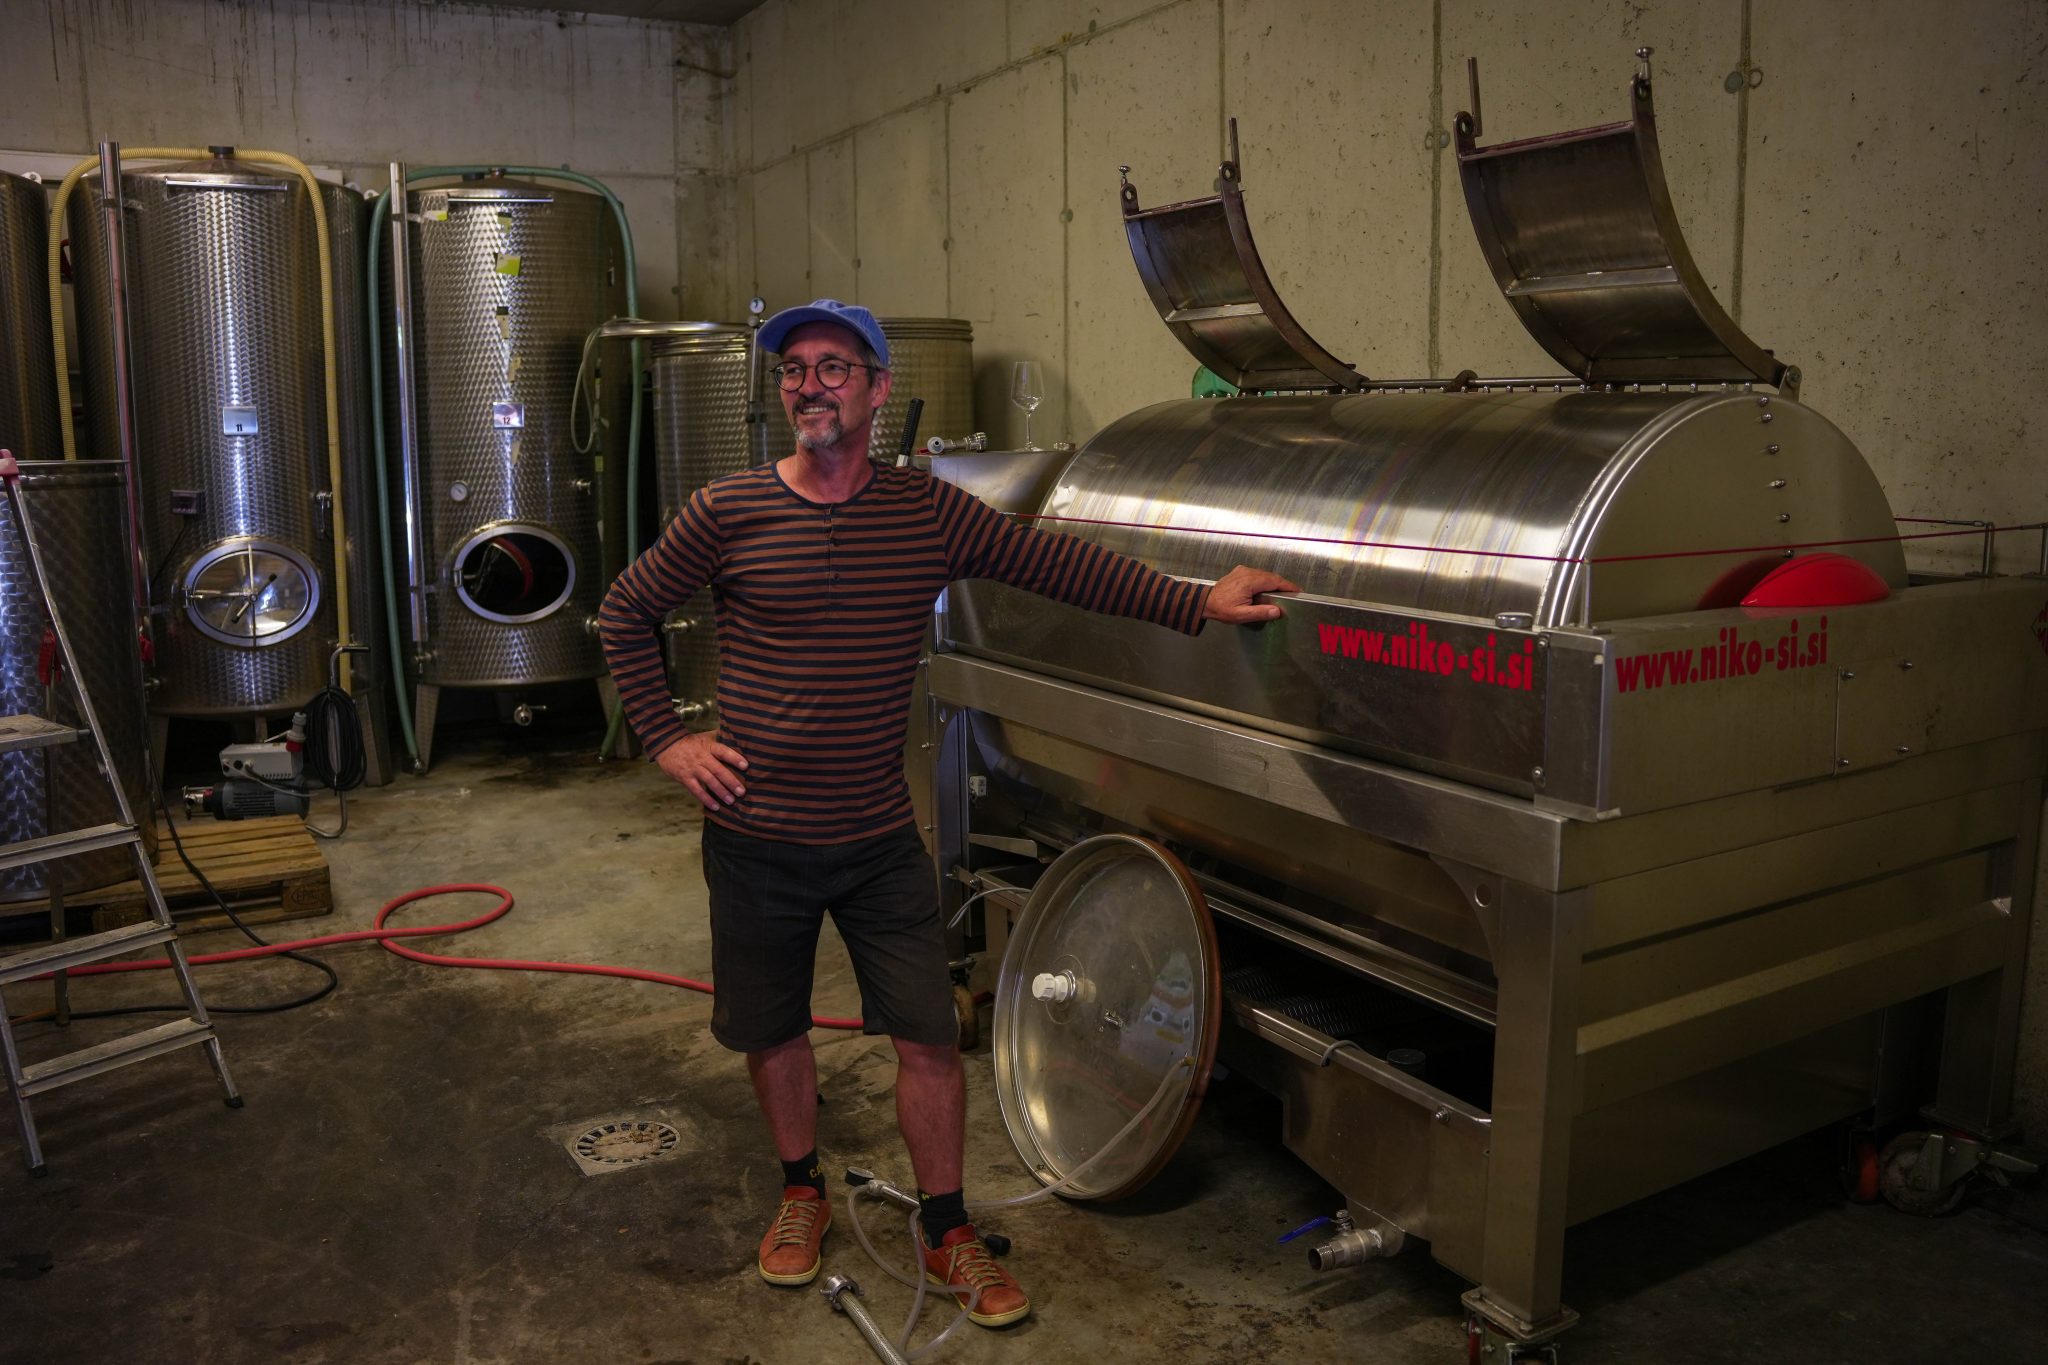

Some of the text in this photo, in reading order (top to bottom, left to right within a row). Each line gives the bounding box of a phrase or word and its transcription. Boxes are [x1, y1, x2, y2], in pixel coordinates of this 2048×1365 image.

[236, 423, 243, 432] 11
[503, 416, 511, 425] 12
[1317, 620, 1534, 691] www.niko-si.si
[1615, 615, 1828, 693] www.niko-si.si
